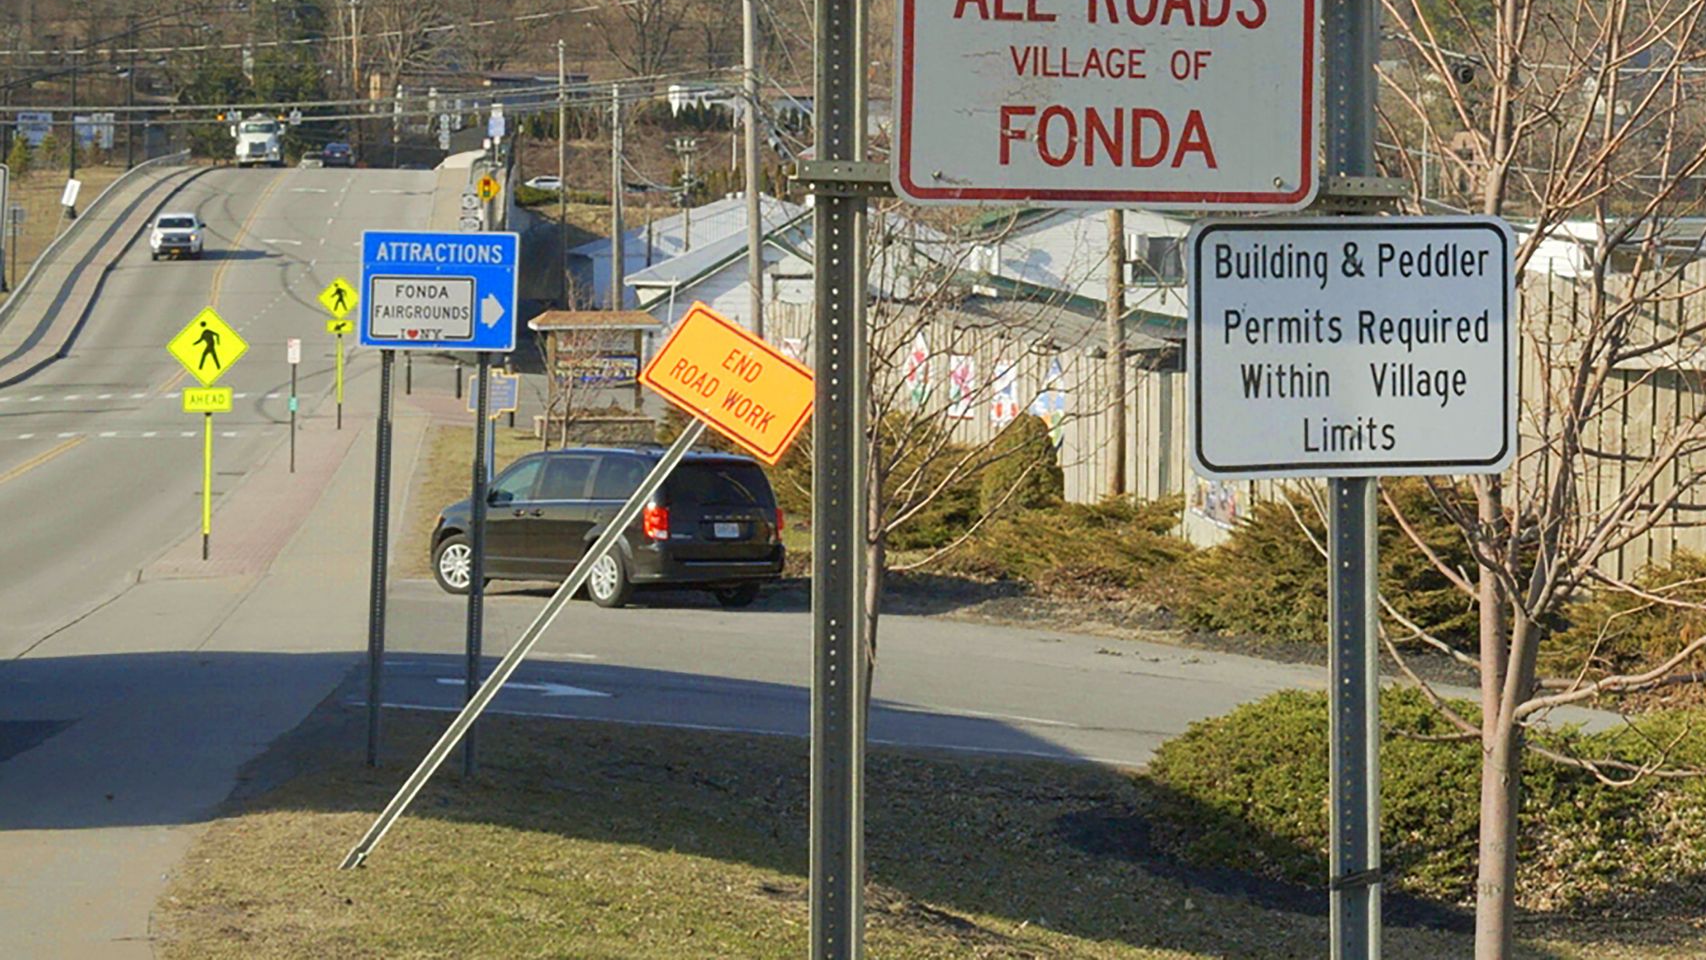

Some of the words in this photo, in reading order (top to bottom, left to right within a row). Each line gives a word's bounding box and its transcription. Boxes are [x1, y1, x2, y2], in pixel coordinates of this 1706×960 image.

[1010, 45, 1146, 80] VILLAGE
[1171, 50, 1213, 81] OF
[999, 105, 1218, 170] FONDA
[376, 241, 503, 264] ATTRACTIONS
[1215, 243, 1328, 290] Building
[1341, 241, 1365, 278] &
[1378, 243, 1490, 278] Peddler
[395, 284, 449, 299] FONDA
[374, 305, 470, 320] FAIRGROUNDS
[1224, 308, 1343, 344] Permits
[1358, 309, 1489, 352] Required
[721, 348, 763, 384] END
[189, 393, 225, 405] AHEAD
[669, 358, 720, 398] ROAD
[721, 388, 776, 434] WORK
[1241, 362, 1331, 399] Within
[1370, 362, 1467, 408] Village
[1303, 416, 1396, 452] Limits
